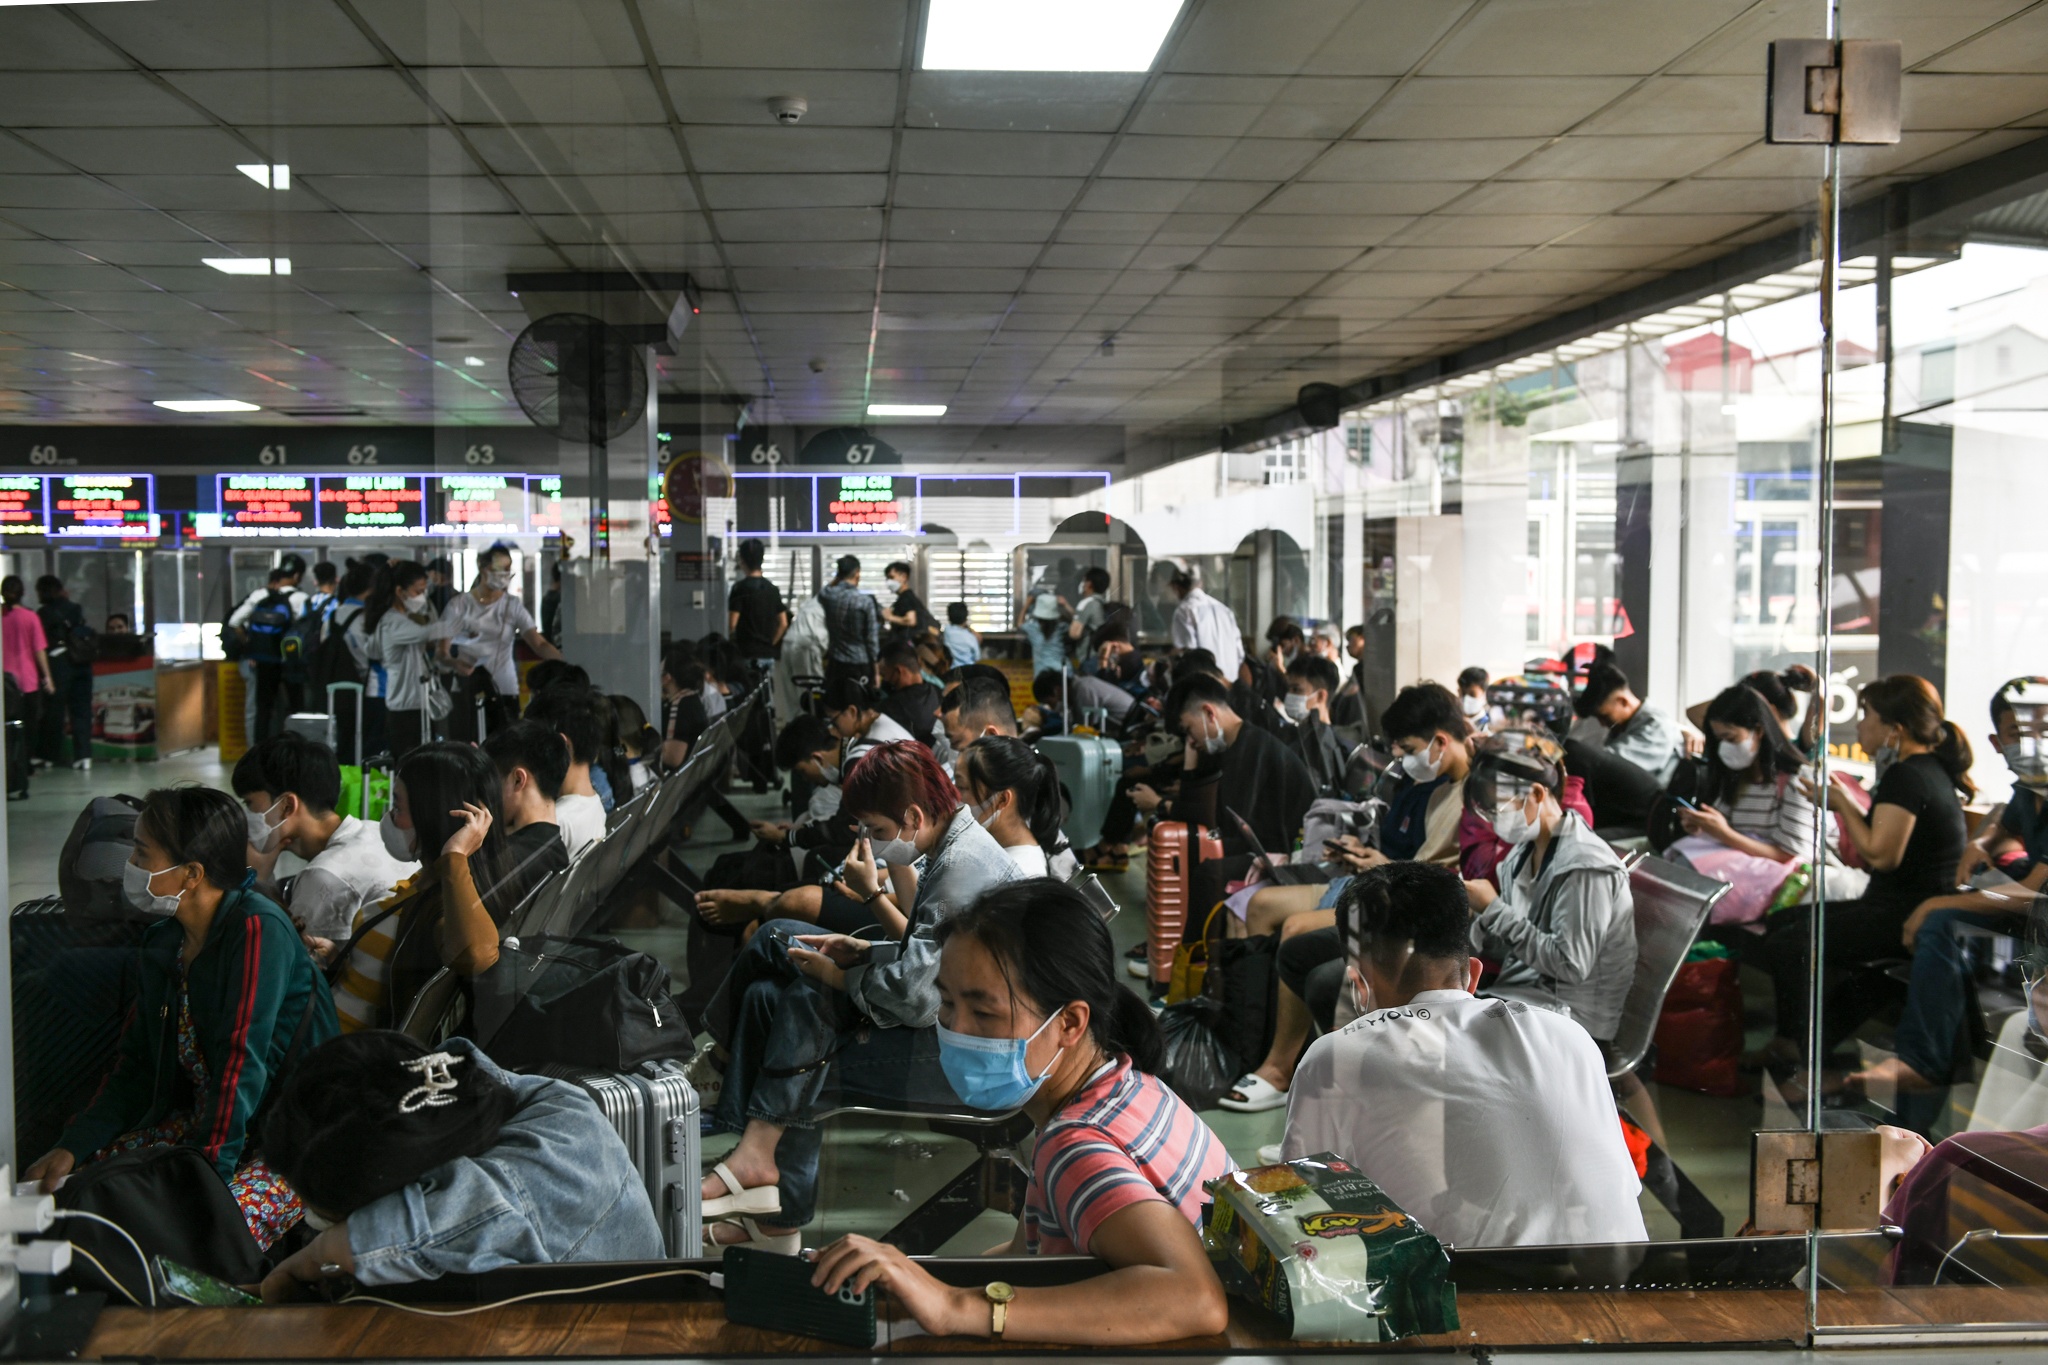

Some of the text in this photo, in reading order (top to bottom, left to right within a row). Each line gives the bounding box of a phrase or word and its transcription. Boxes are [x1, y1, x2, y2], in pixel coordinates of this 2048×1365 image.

[30, 445, 57, 465] 60
[259, 445, 287, 465] 61
[347, 445, 378, 465] 62
[465, 445, 495, 465] 63
[750, 444, 781, 464] 66
[846, 444, 875, 464] 67
